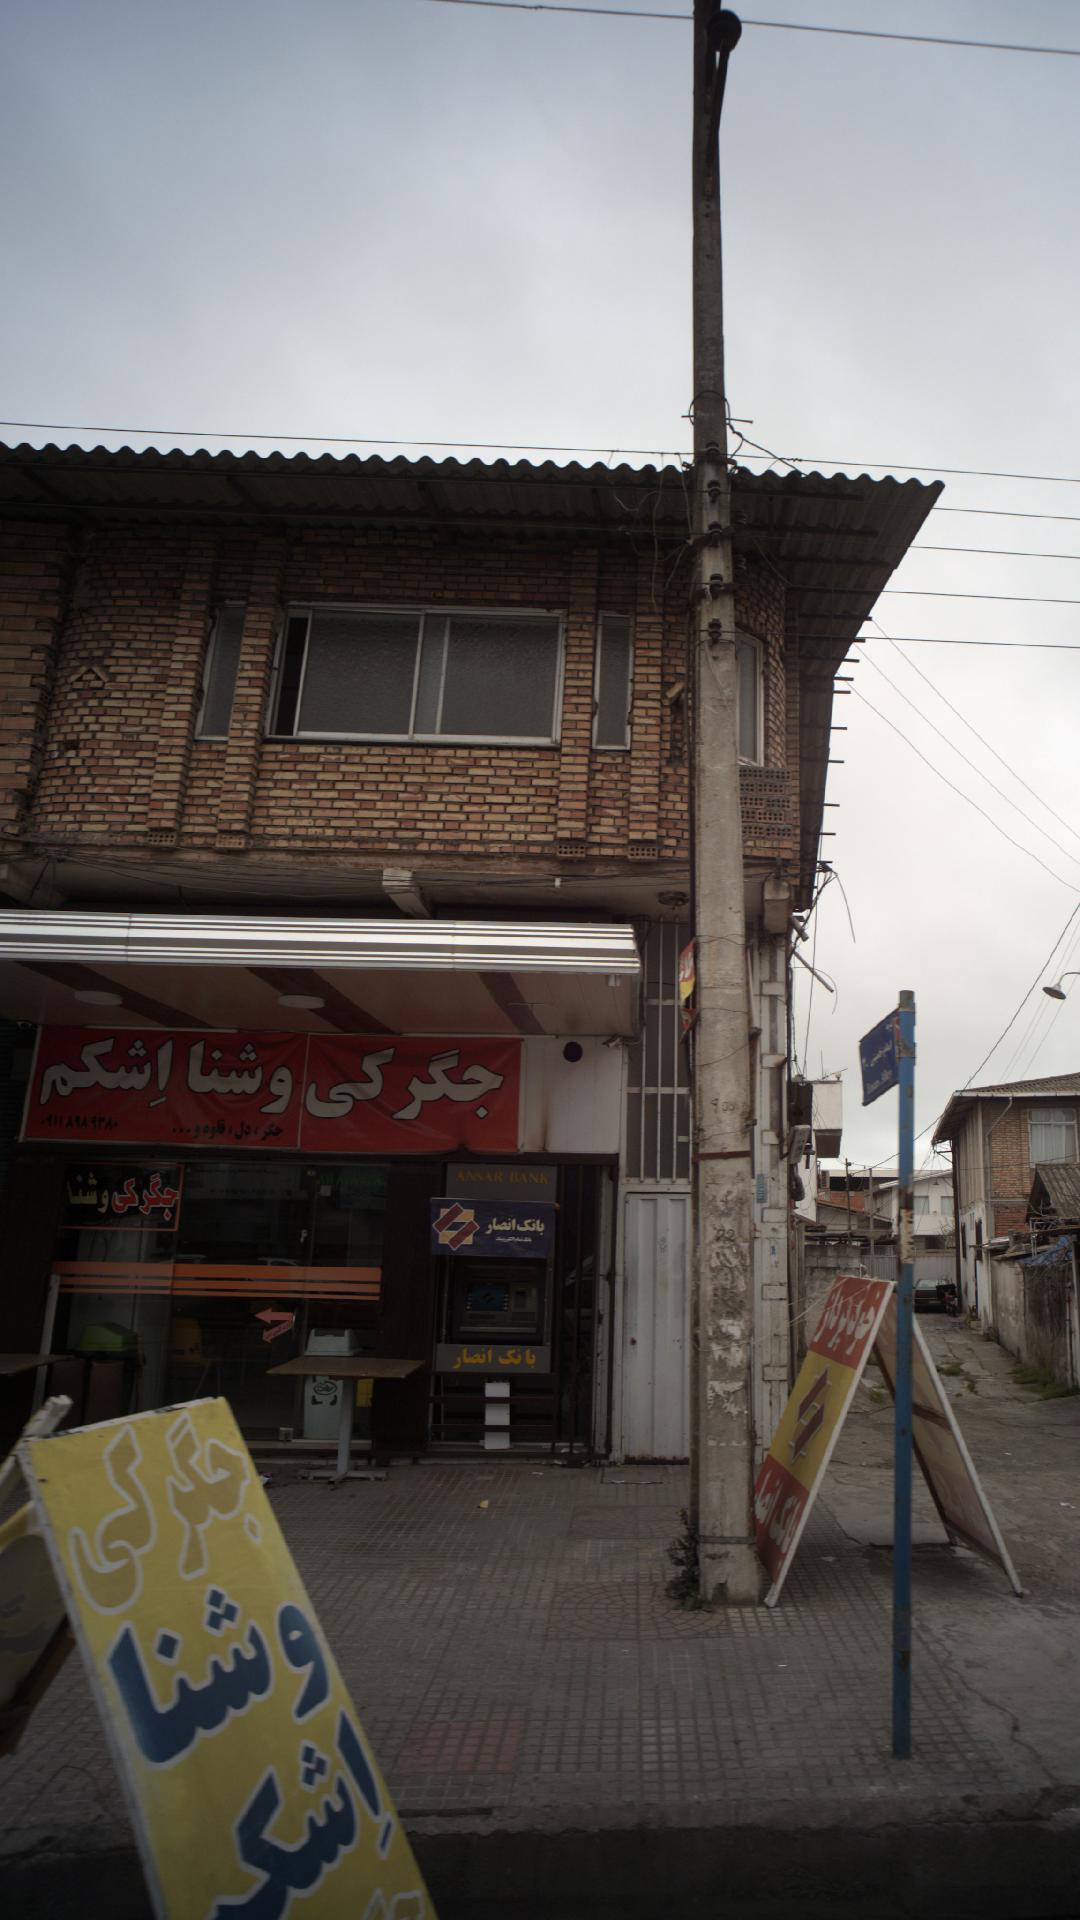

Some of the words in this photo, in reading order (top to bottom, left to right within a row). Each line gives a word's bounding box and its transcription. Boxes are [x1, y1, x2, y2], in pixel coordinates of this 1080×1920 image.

[484, 1216, 516, 1235] انصار
[517, 1217, 545, 1236] بانک
[452, 1345, 493, 1369] انصار
[498, 1345, 537, 1368] بانک
